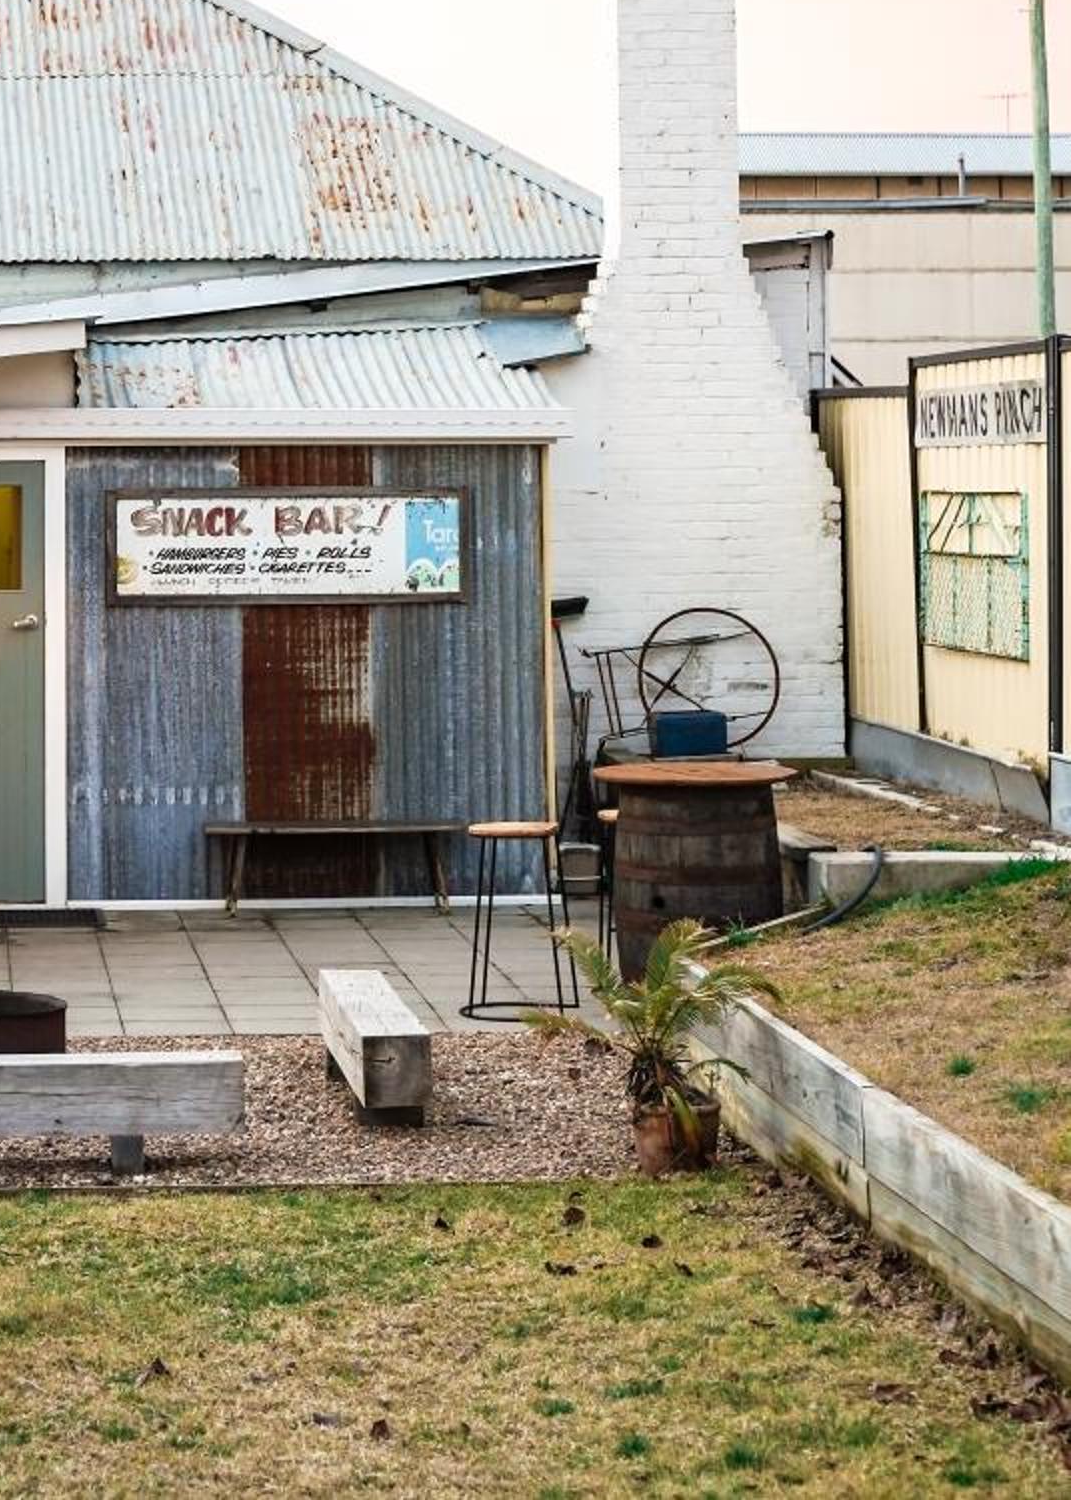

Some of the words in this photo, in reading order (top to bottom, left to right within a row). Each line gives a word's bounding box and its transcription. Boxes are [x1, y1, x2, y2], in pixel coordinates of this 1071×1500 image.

[130, 505, 253, 537] SNACK
[274, 504, 392, 536] BAR!
[155, 547, 246, 561] HAMBURGERS
[262, 547, 299, 560] PIES
[316, 546, 371, 560] ROLLS
[148, 561, 246, 575] SANDWICHES
